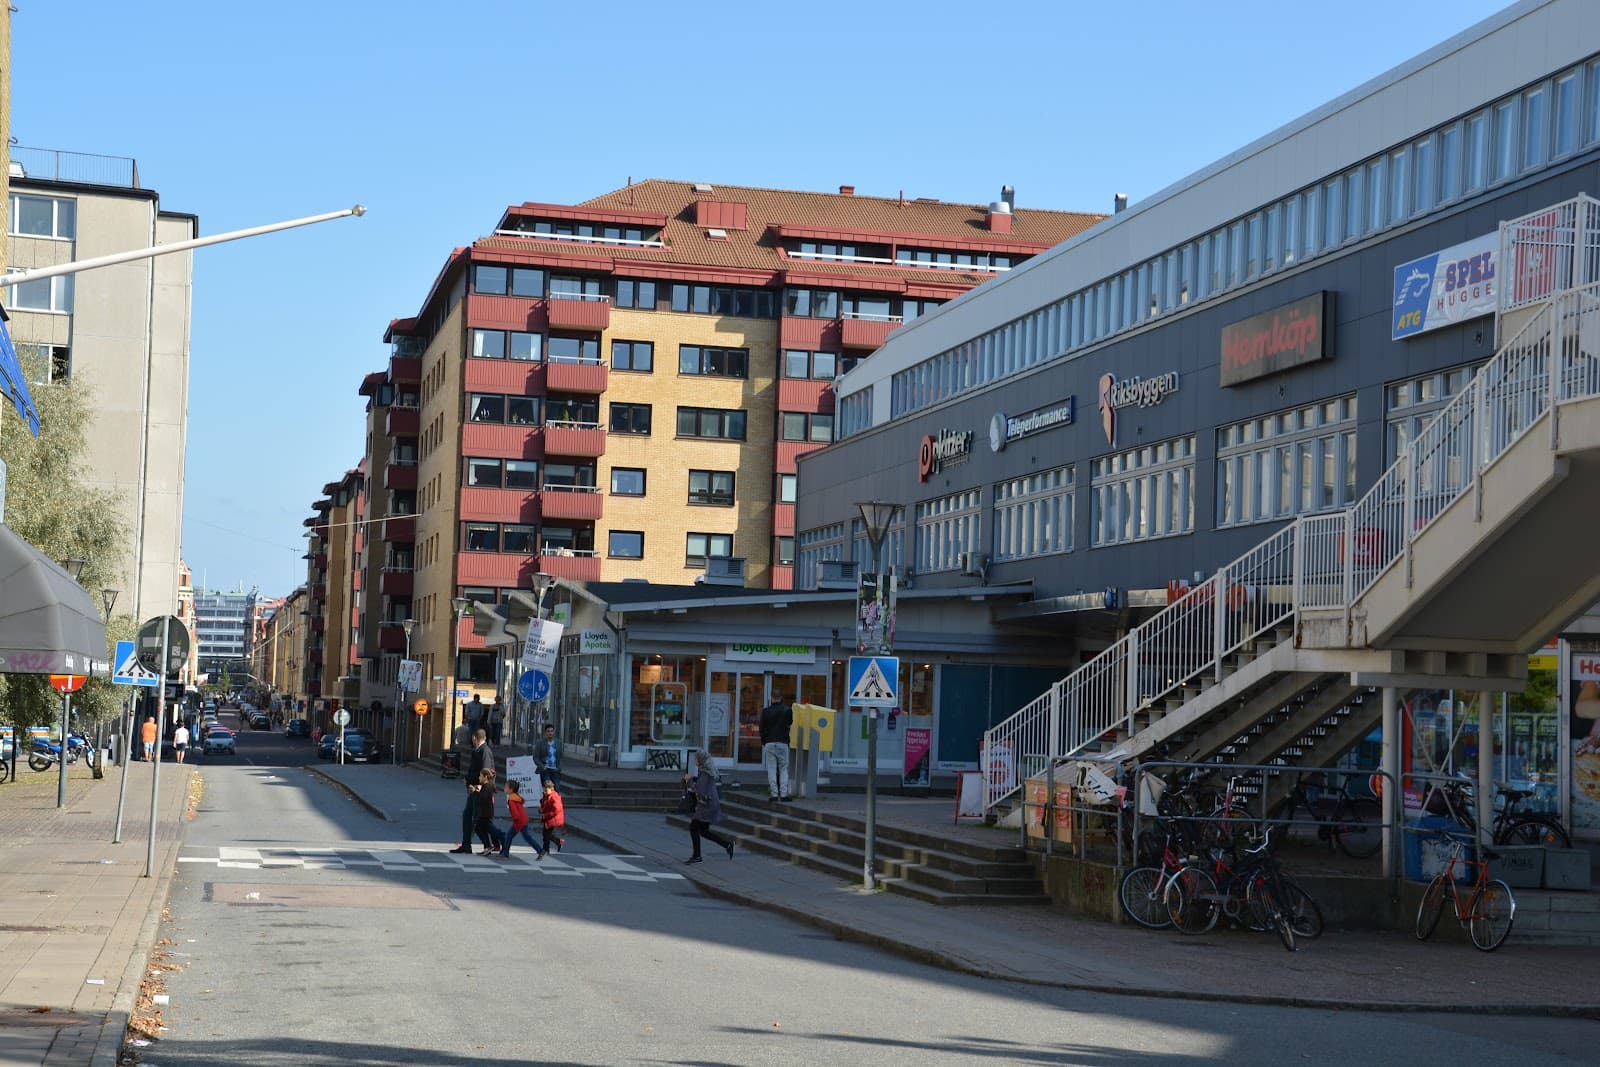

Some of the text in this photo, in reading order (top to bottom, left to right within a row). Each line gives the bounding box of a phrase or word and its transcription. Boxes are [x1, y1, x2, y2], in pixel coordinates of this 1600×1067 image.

[1445, 251, 1495, 292] SPEL
[1437, 282, 1492, 311] HUGGE
[1397, 309, 1421, 330] ATG
[1223, 308, 1317, 370] Hemköp
[1110, 372, 1176, 408] Riksbyggen
[1007, 406, 1068, 438] Teleperformance
[584, 632, 608, 641] Lloyds
[585, 641, 611, 650] Apotek
